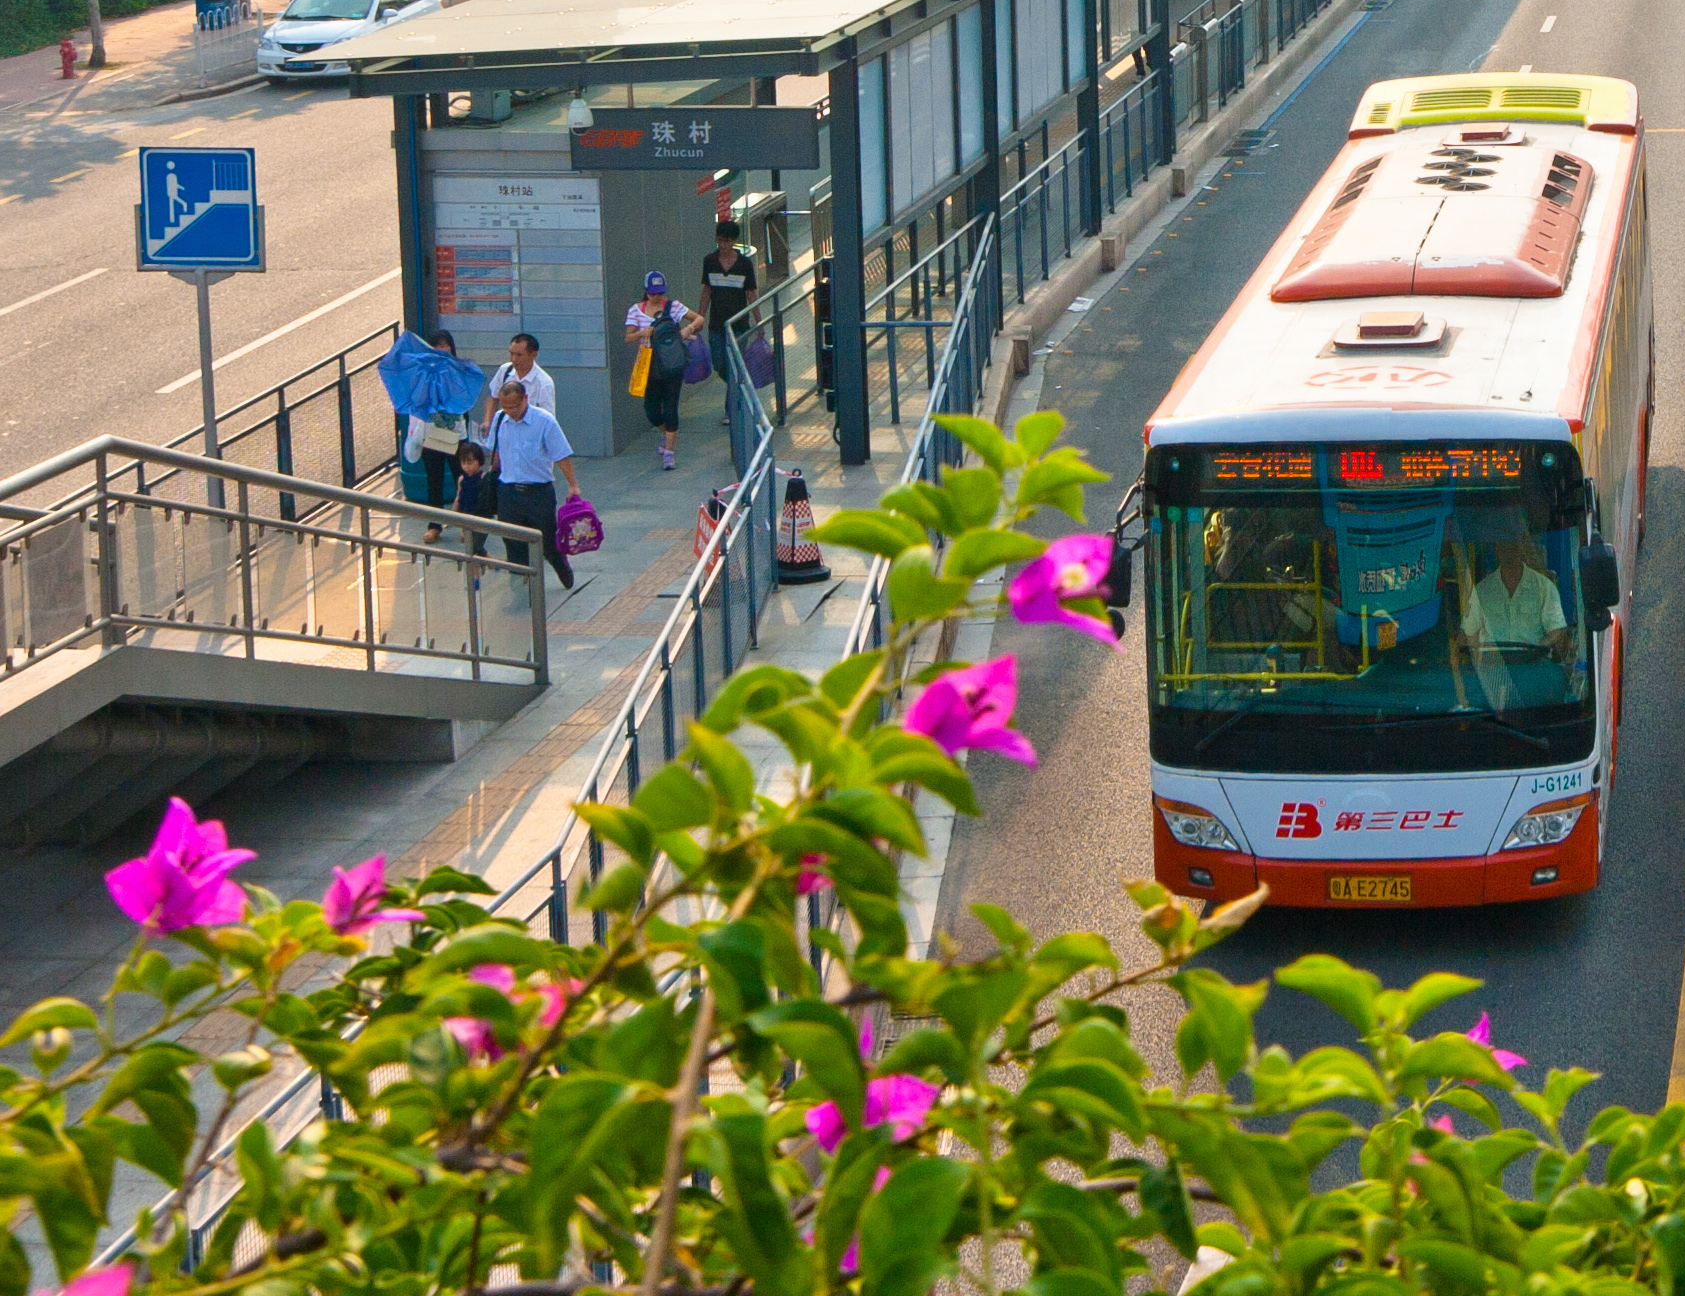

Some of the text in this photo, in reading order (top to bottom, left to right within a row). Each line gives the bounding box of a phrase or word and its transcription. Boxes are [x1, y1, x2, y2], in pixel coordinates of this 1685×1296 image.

[651, 120, 712, 144] 珠村
[655, 147, 704, 158] Zhucun
[498, 185, 533, 197] 珠村站
[1531, 772, 1581, 794] J-G1241
[1334, 810, 1464, 832] 第三巴士
